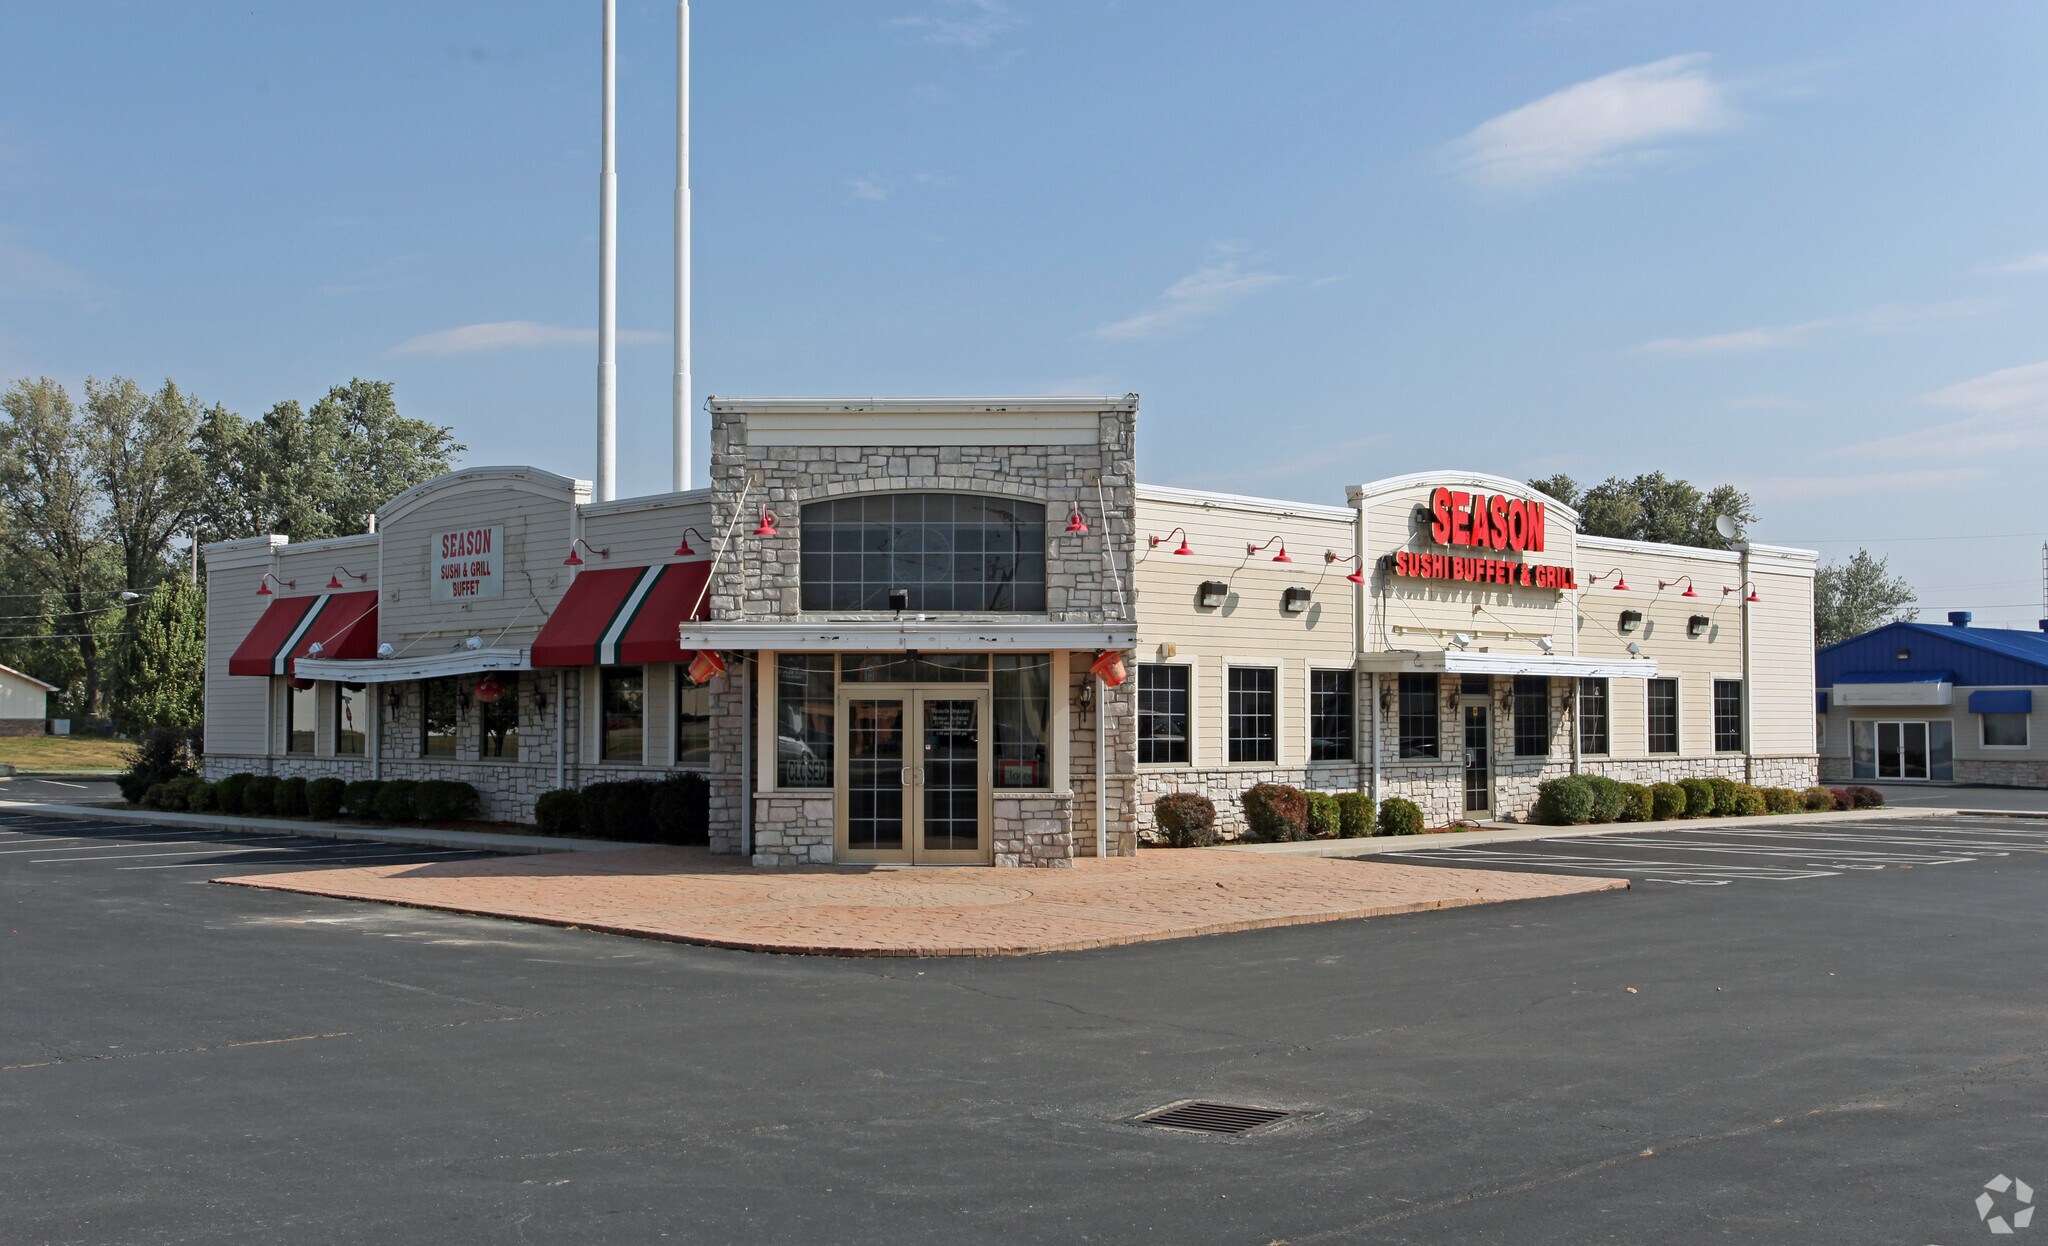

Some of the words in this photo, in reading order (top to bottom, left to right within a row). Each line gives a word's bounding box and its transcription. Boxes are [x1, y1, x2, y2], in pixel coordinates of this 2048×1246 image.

[1432, 487, 1545, 552] SEASON
[442, 528, 492, 559] SEASON
[440, 563, 461, 580] SUSHI
[463, 562, 468, 577] &
[470, 561, 491, 576] GRILL
[1395, 550, 1449, 579] SUSHI
[1453, 555, 1516, 585] BUFFET
[1520, 563, 1532, 587] &
[1535, 564, 1578, 590] GRILL
[452, 579, 480, 597] BUFFET
[788, 761, 826, 781] CLOSED
